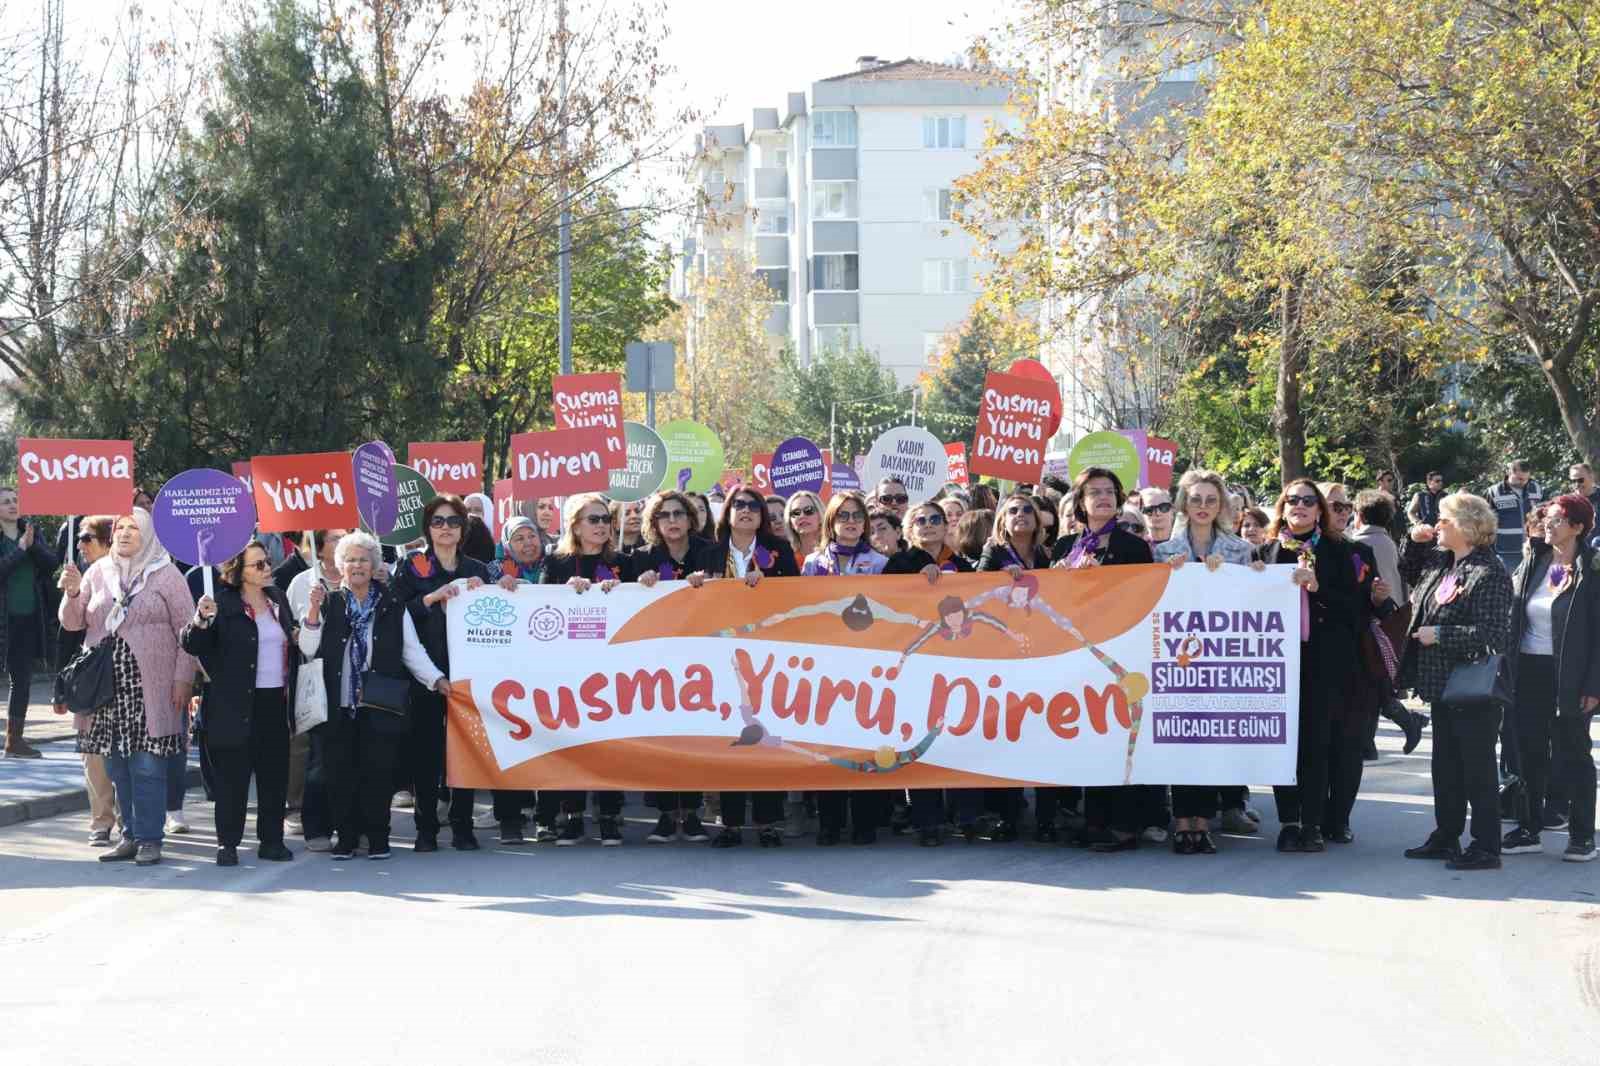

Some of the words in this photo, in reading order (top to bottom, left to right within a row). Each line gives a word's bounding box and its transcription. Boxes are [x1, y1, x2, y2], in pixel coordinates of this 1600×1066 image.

[555, 389, 619, 413] Susma
[985, 389, 1051, 417] Susma
[563, 408, 617, 428] Yürü
[986, 412, 1042, 440] Yürü
[897, 440, 924, 456] KADIN
[977, 435, 1039, 465] Diren
[21, 451, 131, 485] Susma
[413, 458, 476, 481] Diren
[519, 450, 601, 481] Diren
[881, 454, 935, 476] DAYANIŞMASI
[397, 480, 420, 496] ALET
[609, 472, 640, 488] ADALET
[165, 487, 221, 497] HAKLARIMIZ
[222, 486, 241, 497] İÇİN
[172, 497, 222, 506] MÜCADELE
[263, 472, 345, 513] Yürü
[172, 506, 237, 516] DAYANIŞMAYA
[398, 494, 425, 513] ERÇEK
[190, 517, 221, 525] DEVAM
[467, 627, 512, 637] NİLÜFER
[1163, 611, 1285, 633] KADINA
[1163, 633, 1285, 658] YÖNELİK
[1155, 663, 1227, 692] ŞİDDETE
[1231, 666, 1281, 692] KARŞI
[491, 662, 731, 741] Susma,
[734, 648, 913, 742] Yürü,
[928, 671, 1134, 743] Diren
[1152, 696, 1287, 710] ULUSLARARASI
[1157, 716, 1237, 737] MÜCADELE
[1239, 716, 1280, 737] GÜNÜ
